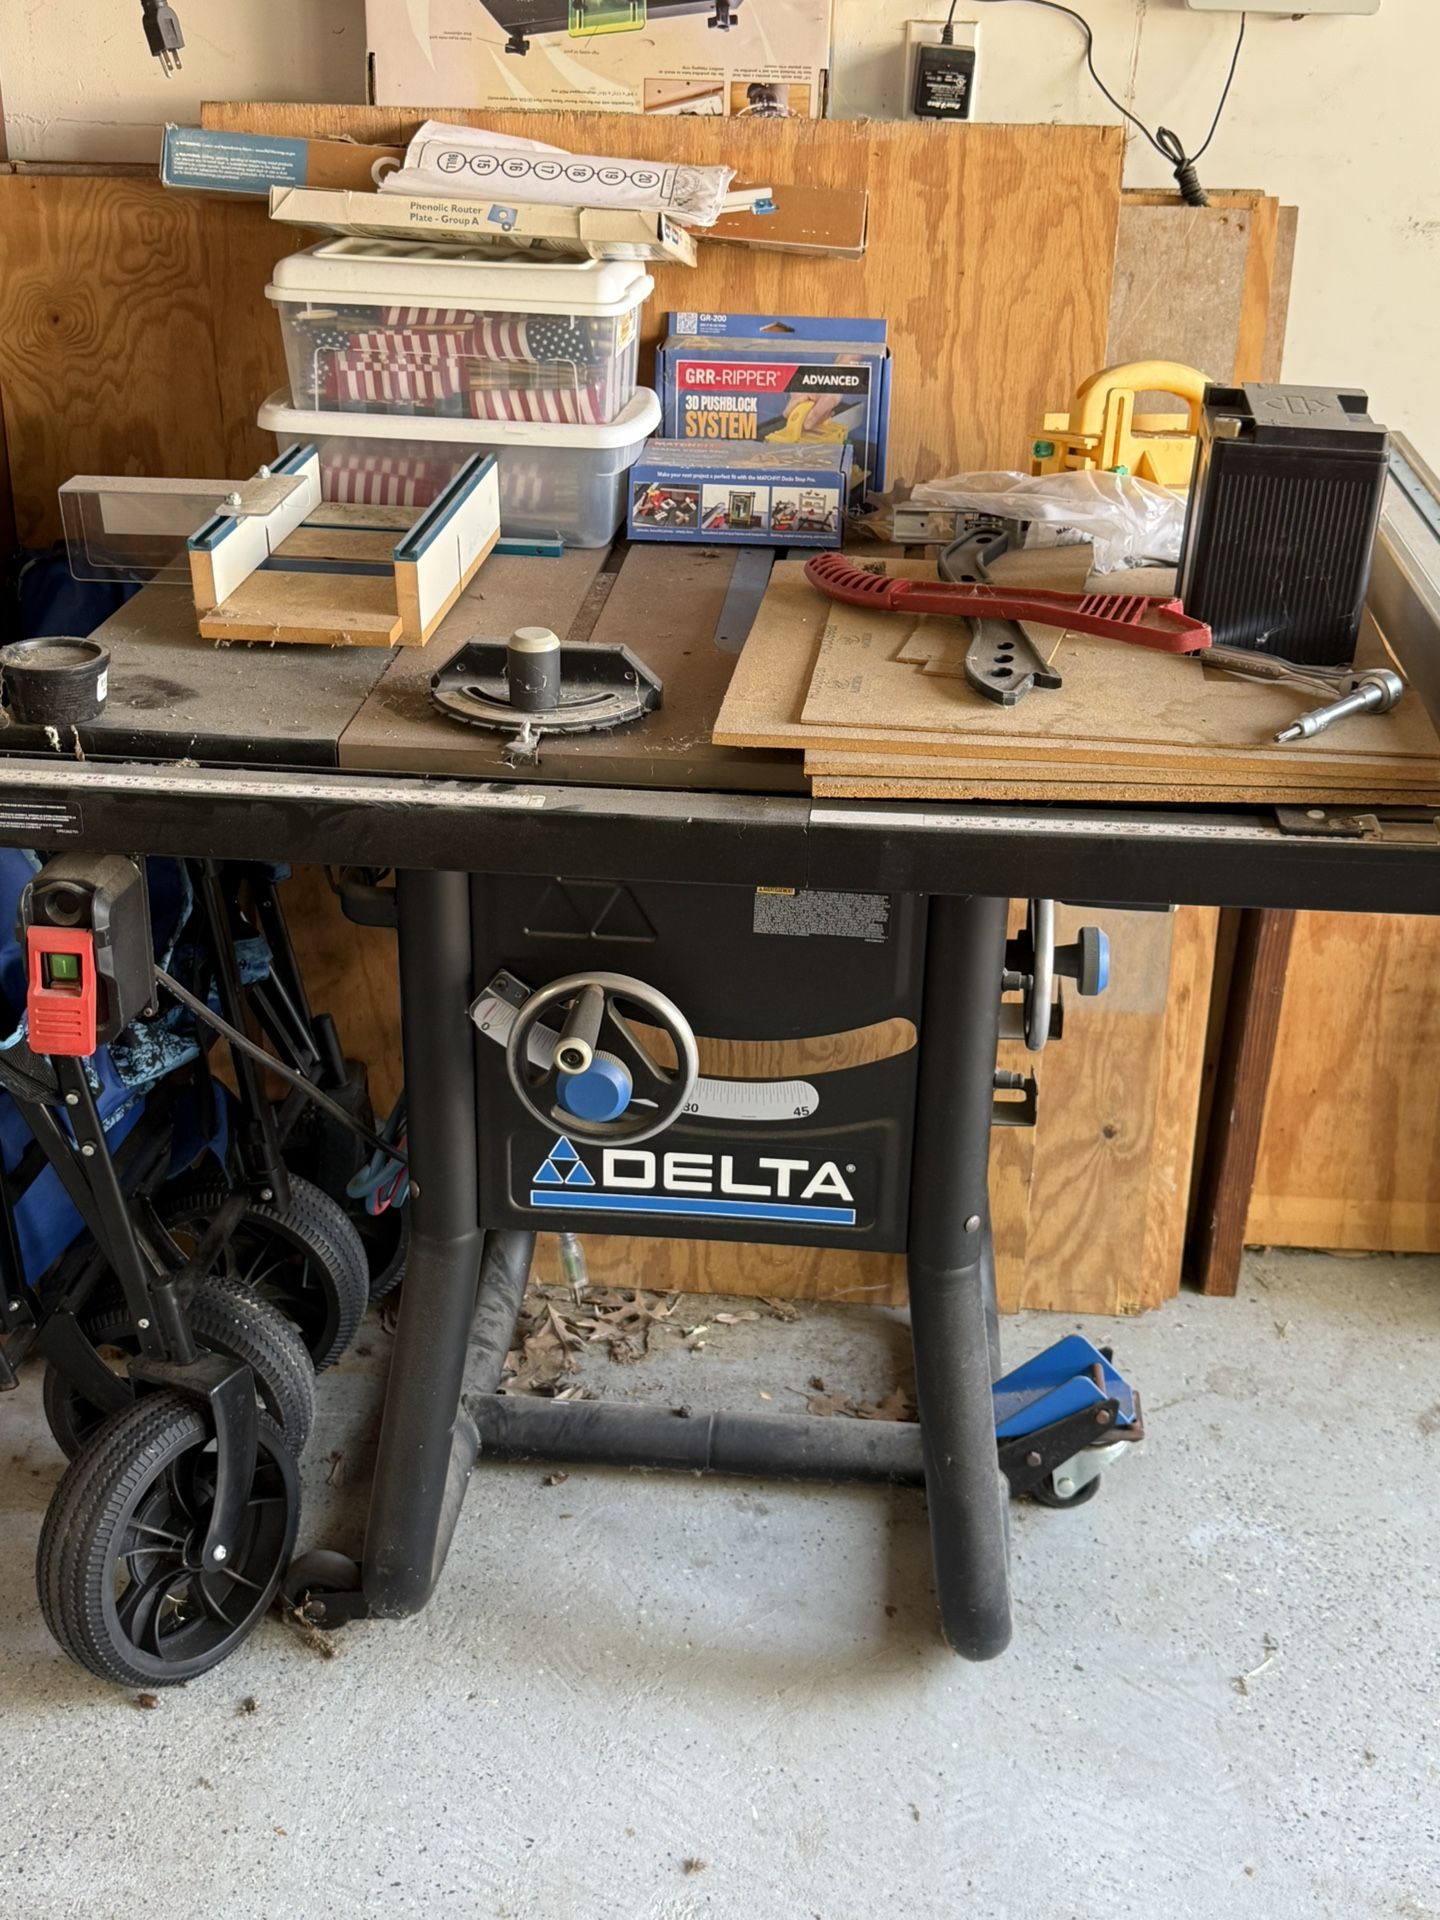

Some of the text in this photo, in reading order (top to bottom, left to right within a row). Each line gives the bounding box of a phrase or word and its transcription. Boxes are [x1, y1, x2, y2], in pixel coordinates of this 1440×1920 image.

[447, 153, 459, 171] BULL
[477, 158, 490, 169] 15
[509, 161, 523, 172] 16
[541, 164, 555, 174] 17
[572, 167, 586, 177] 18
[605, 171, 619, 180] 19
[637, 173, 652, 184] 20
[410, 201, 483, 214] Phenolic Router
[410, 213, 433, 222] Plate
[441, 214, 470, 227] Group
[471, 217, 480, 226] A
[700, 313, 727, 324] GR-200
[802, 374, 859, 387] ADVANCED
[685, 395, 757, 412] 3D PUSHBLOCK
[685, 411, 757, 439] SYSTEM
[481, 1022, 490, 1031] 0
[793, 1106, 810, 1116] 45
